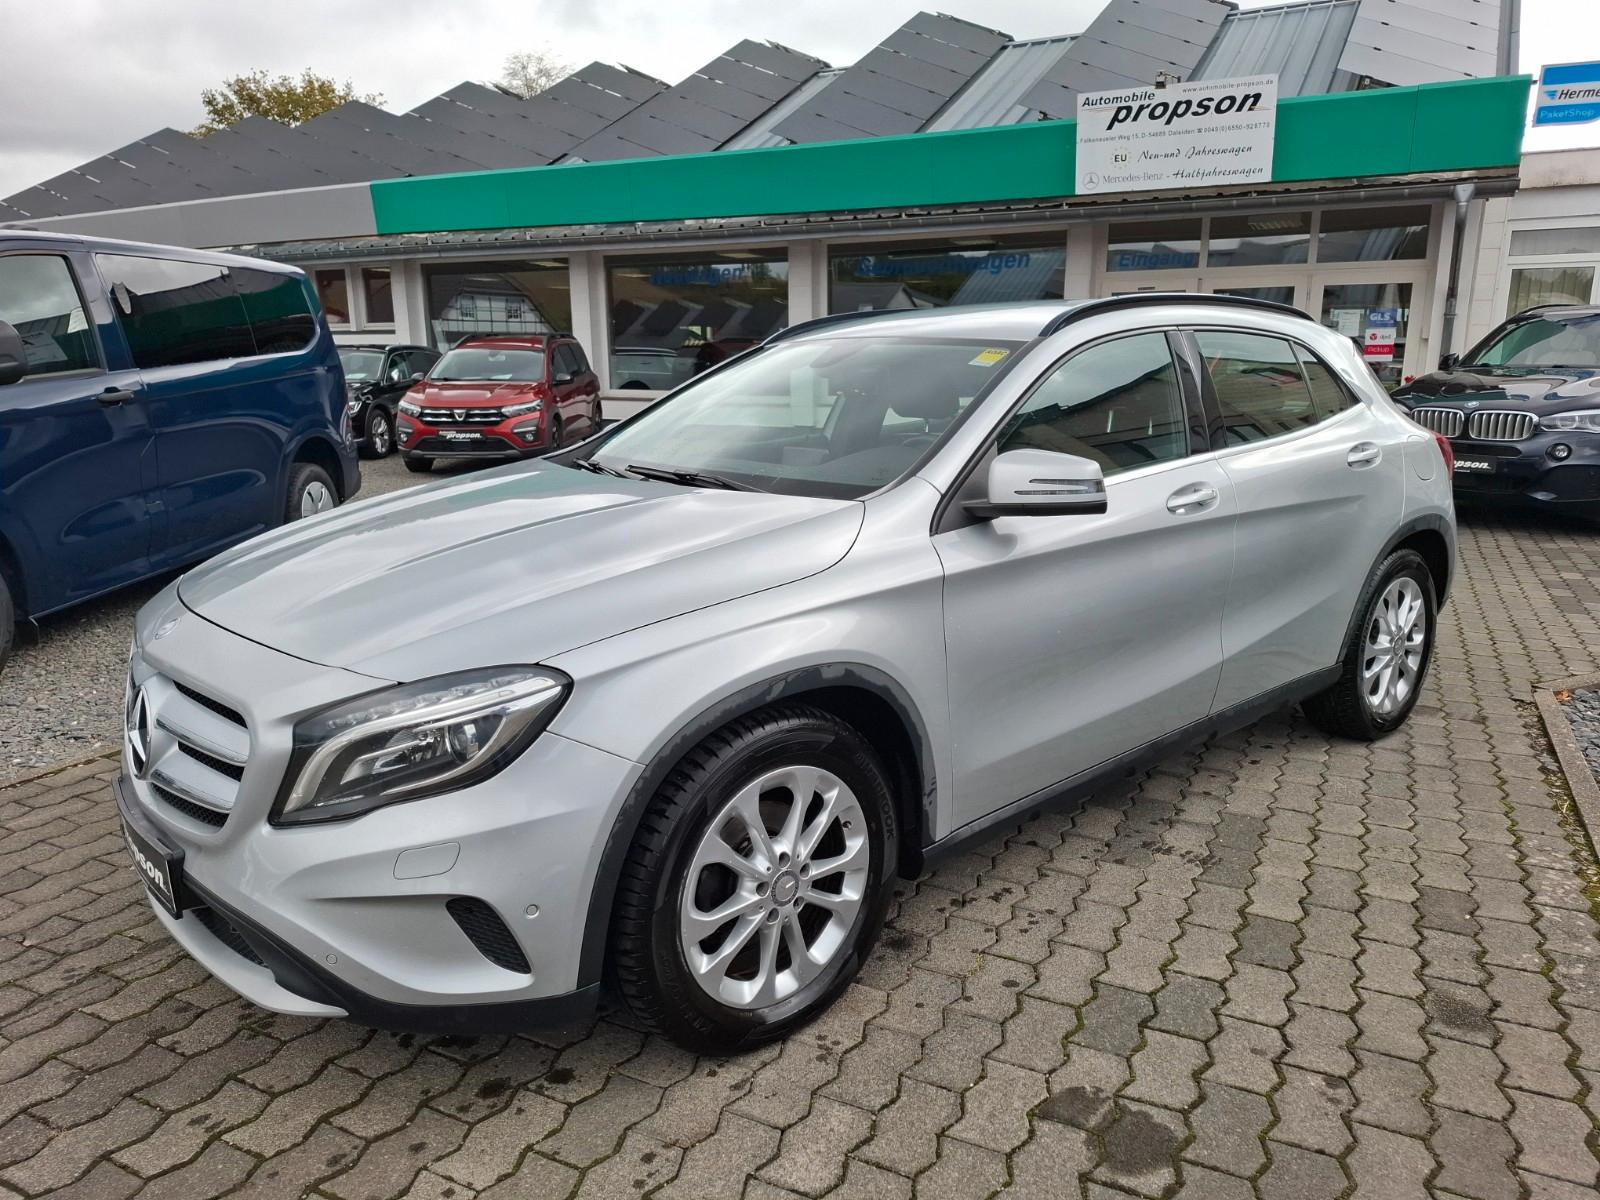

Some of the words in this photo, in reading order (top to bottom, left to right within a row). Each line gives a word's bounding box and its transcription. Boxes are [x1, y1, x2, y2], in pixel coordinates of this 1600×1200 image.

[1082, 91, 1156, 108] Automobile
[1558, 88, 1600, 100] Herme
[1105, 91, 1263, 131] propson
[1541, 109, 1595, 118] PaketShop
[1113, 153, 1128, 163] EU
[1184, 145, 1252, 159] Jahreswagen
[1102, 171, 1164, 185] Mercedes-Benz
[1119, 252, 1197, 269] Eingang
[1369, 312, 1391, 321] GLS
[1453, 460, 1489, 469] pson
